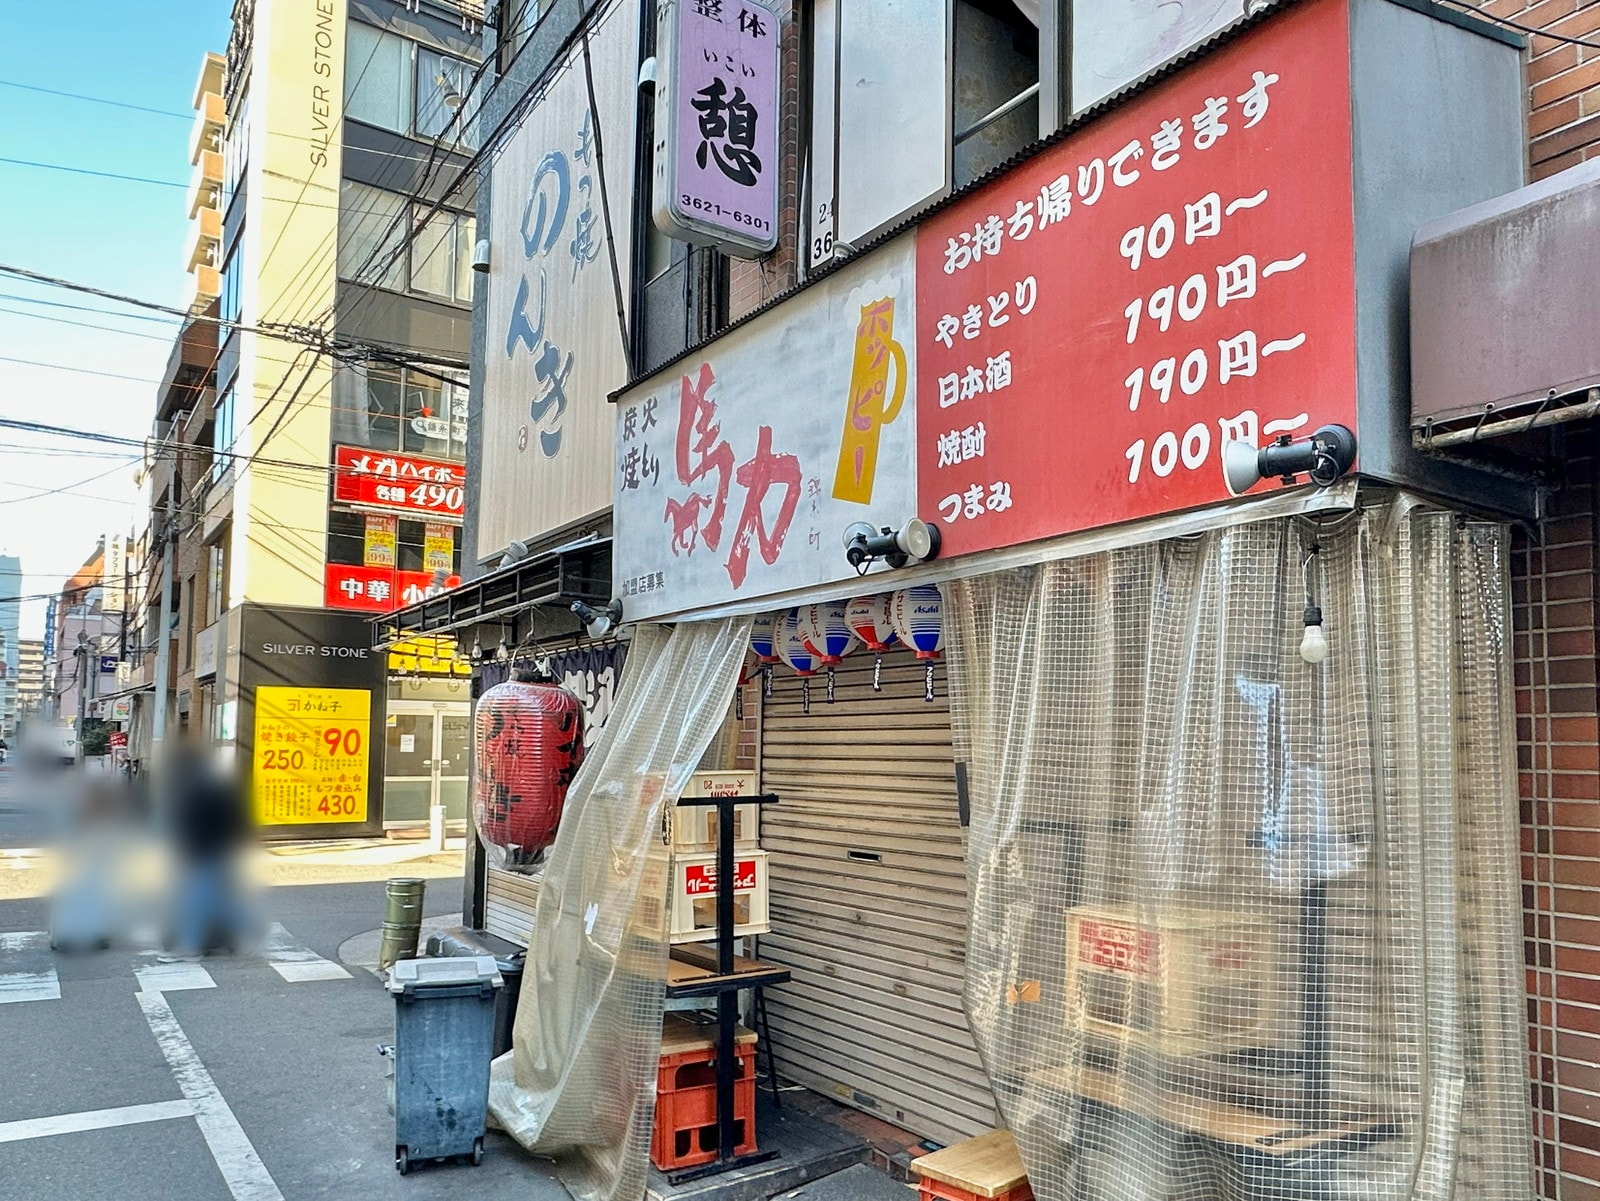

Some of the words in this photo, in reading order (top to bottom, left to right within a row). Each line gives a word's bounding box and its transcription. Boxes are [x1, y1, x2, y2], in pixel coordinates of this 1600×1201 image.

[691, 0, 767, 39] 整体
[314, 0, 334, 78] STONE
[703, 48, 756, 78] いこい
[309, 85, 331, 168] SILVER
[690, 77, 763, 188] 憩
[941, 70, 1280, 276] お持ち帰りできます
[681, 194, 771, 232] 3621-6301
[813, 231, 833, 260] 36
[505, 150, 575, 459] のんき
[934, 275, 1039, 350] やきとり
[850, 298, 893, 489] ホッピー
[937, 350, 1014, 410] 日本酒
[936, 421, 986, 469] 焼酎
[665, 361, 803, 590] 馬力
[409, 483, 464, 511] 490
[938, 480, 1014, 524] つまみ
[340, 577, 391, 603] 中華
[622, 571, 665, 598] 加盟店募集
[830, 610, 844, 618] Asa
[914, 604, 939, 614] Asahi
[262, 643, 315, 656] SILVER
[320, 645, 369, 659] STONE
[303, 699, 342, 713] かね子
[261, 731, 311, 743] 焼き餃子
[323, 727, 361, 756] 90
[262, 749, 304, 771] 250
[317, 794, 356, 816] 430
[687, 873, 755, 893] アサビール
